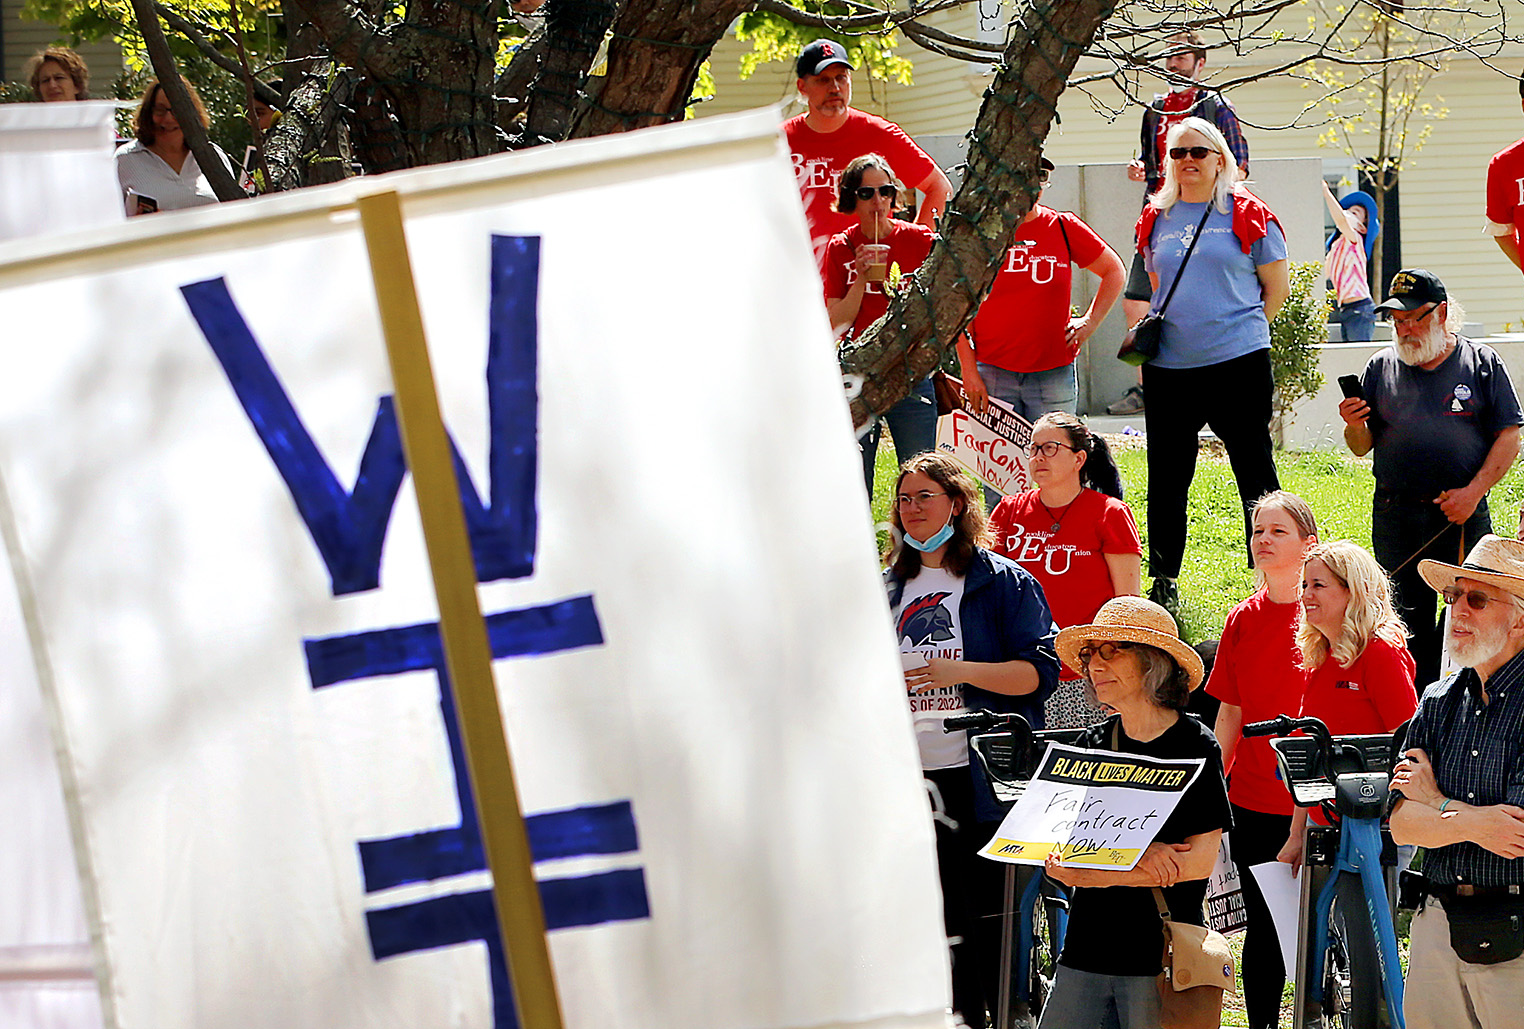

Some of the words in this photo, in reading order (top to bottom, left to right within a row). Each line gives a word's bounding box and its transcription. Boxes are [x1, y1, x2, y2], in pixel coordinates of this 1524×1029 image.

[1002, 413, 1031, 440] JUSTICE
[920, 698, 934, 711] OF
[937, 697, 963, 712] 2022
[1050, 757, 1098, 780] BLACK
[1098, 763, 1131, 781] LIVES
[1130, 766, 1187, 786] MATTER
[1045, 790, 1103, 814] Fair
[1051, 809, 1158, 833] contract
[998, 844, 1024, 855] MTA
